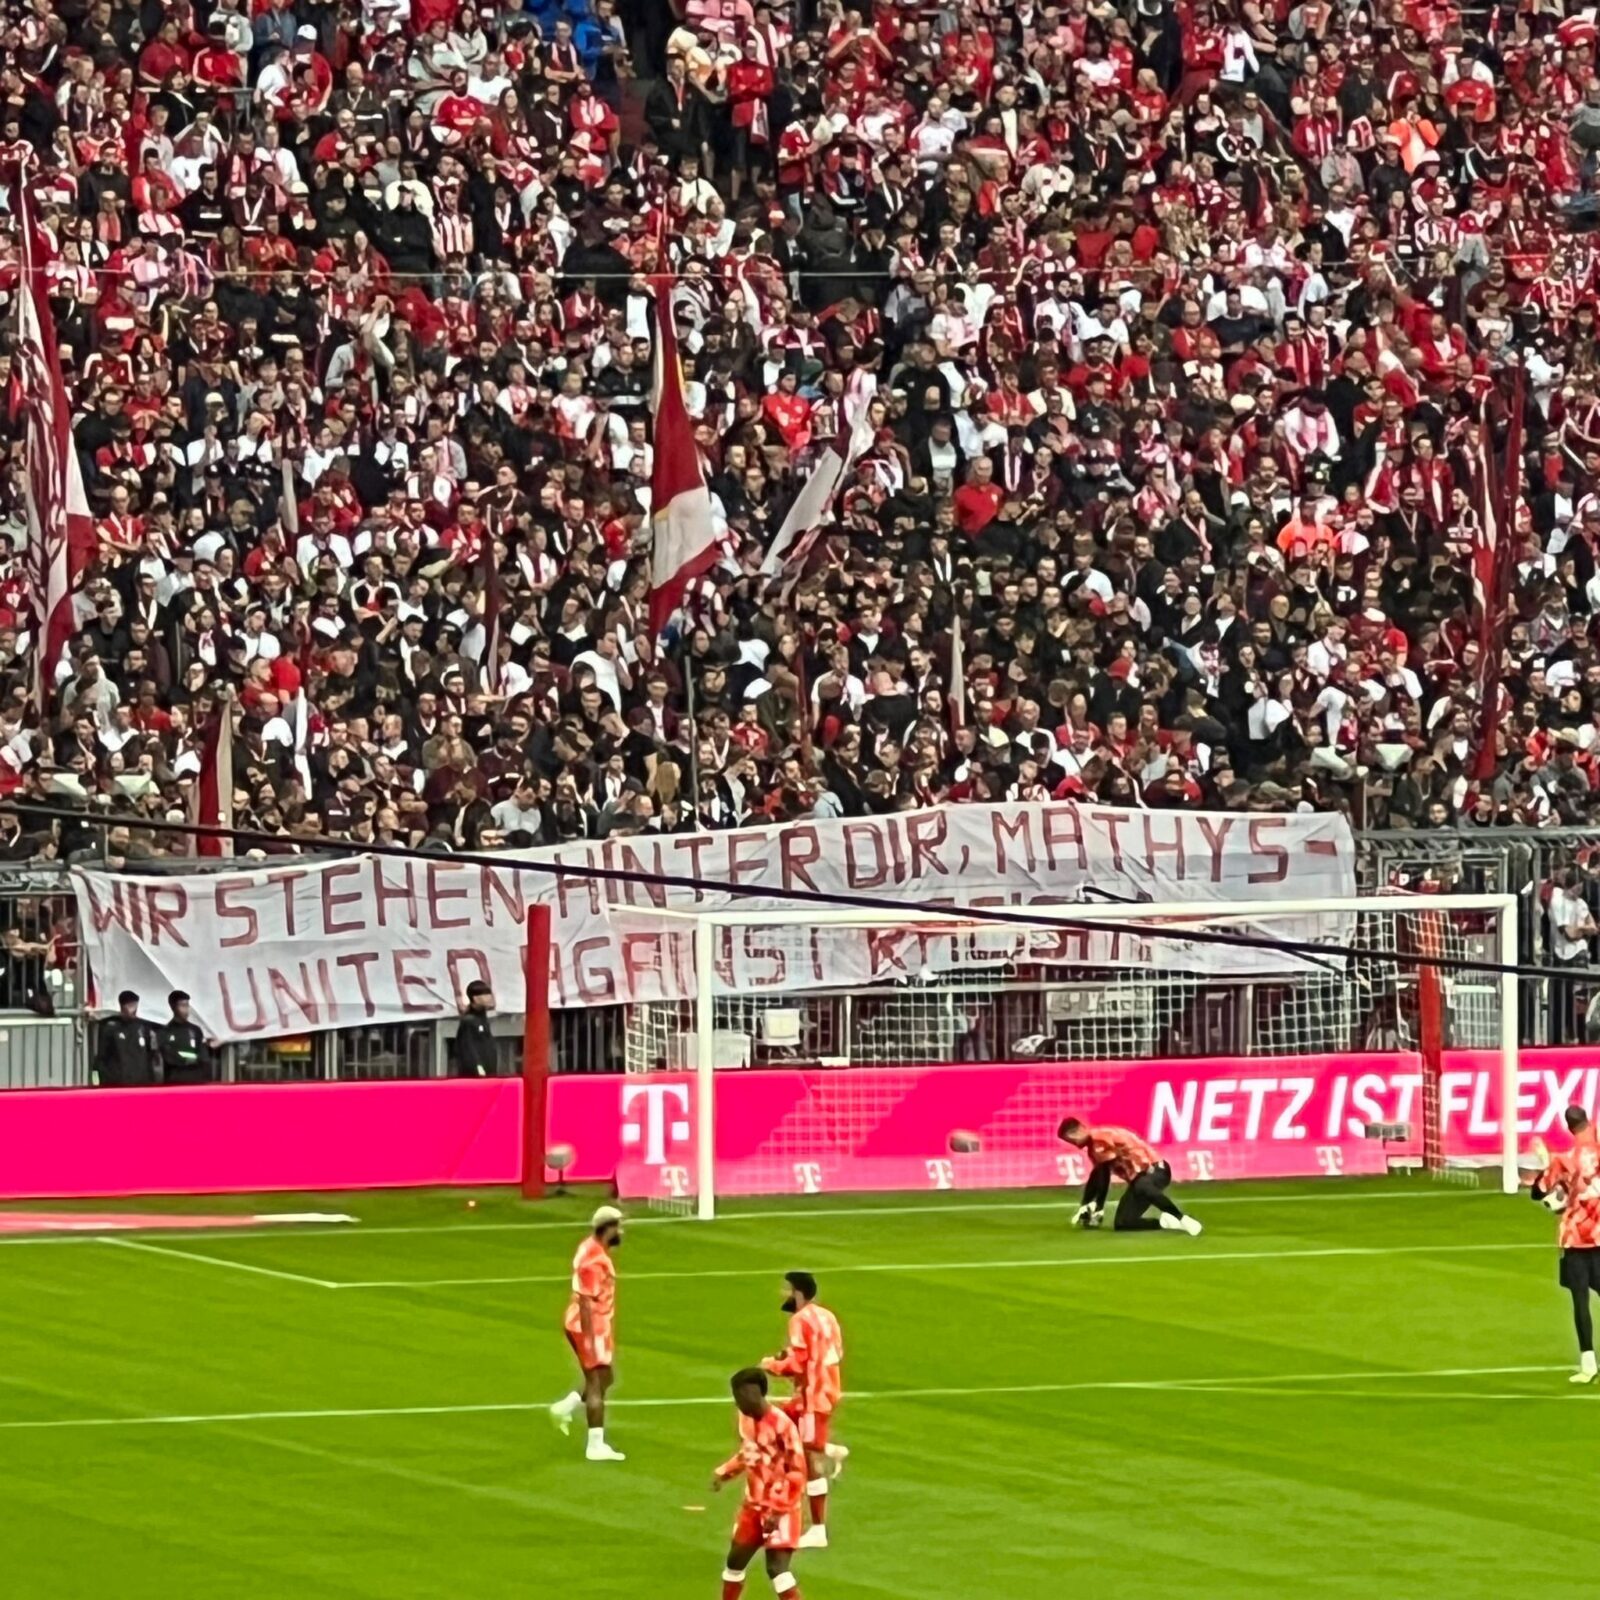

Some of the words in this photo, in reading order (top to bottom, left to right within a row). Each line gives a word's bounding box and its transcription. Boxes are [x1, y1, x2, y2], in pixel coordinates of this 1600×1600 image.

[84, 874, 190, 947] WIR
[215, 855, 524, 947] STEHEN
[554, 825, 820, 918] HINTER
[843, 809, 970, 888] DIR,
[217, 948, 496, 1033] UNITED
[1150, 1077, 1315, 1143] NETZ
[1327, 1073, 1424, 1139] IST
[1440, 1067, 1600, 1134] FLEXI
